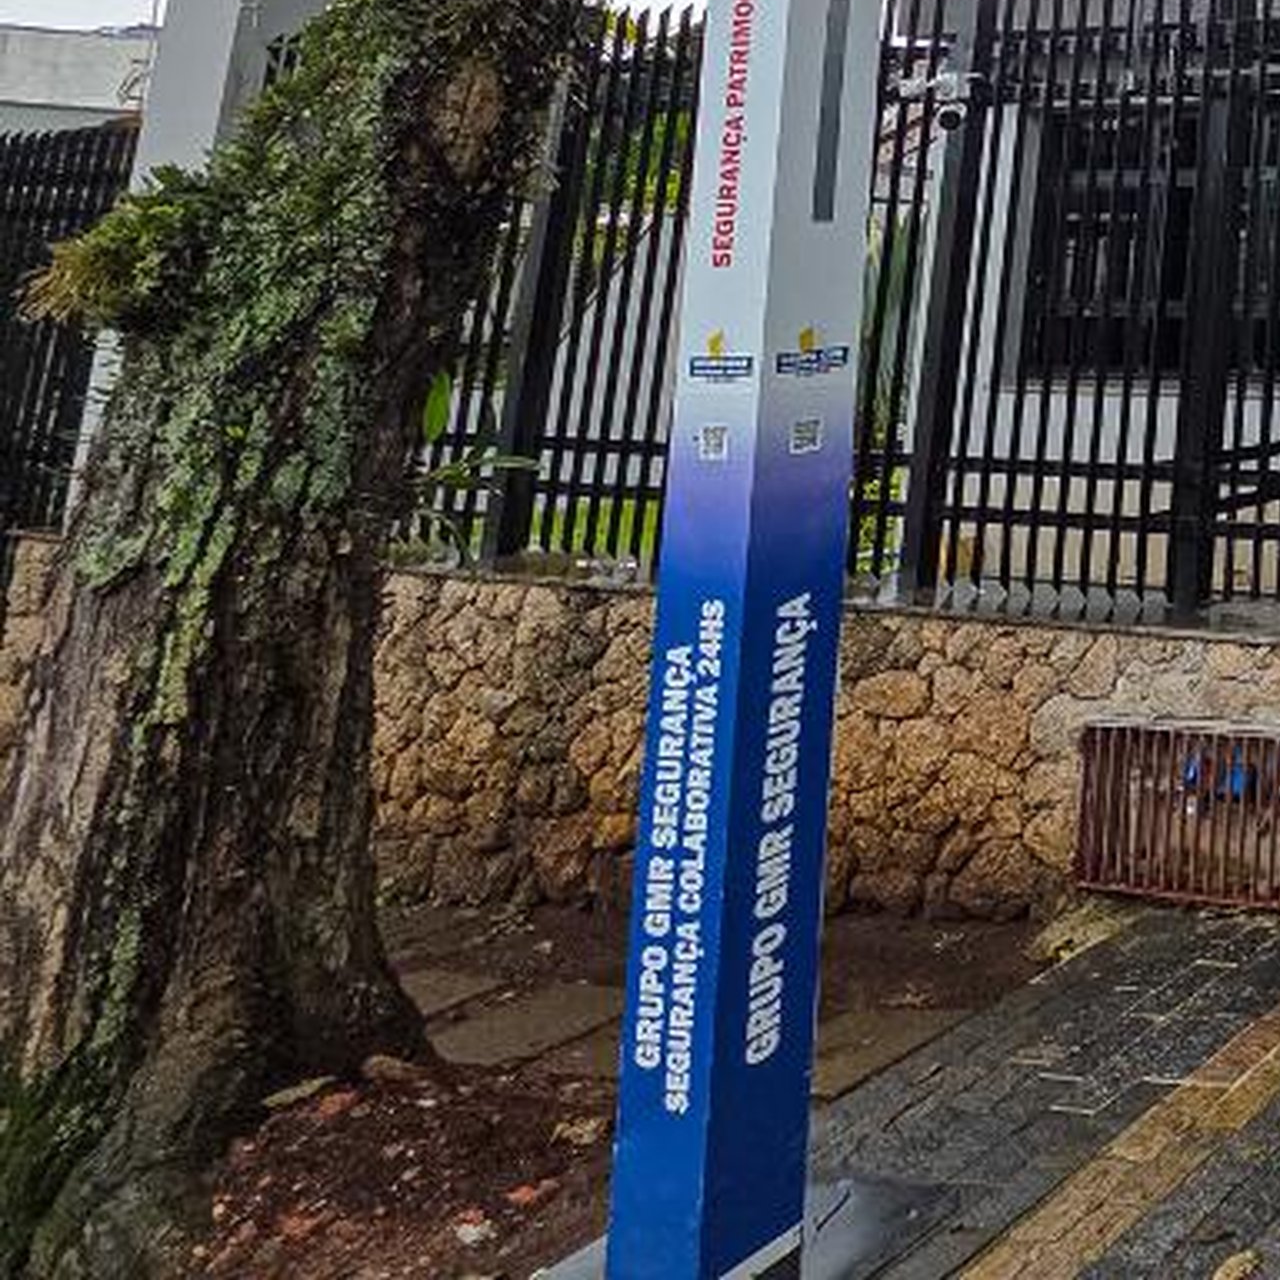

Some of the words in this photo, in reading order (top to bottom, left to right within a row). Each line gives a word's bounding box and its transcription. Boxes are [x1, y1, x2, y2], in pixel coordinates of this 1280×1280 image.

[712, 114, 748, 268] SEGURANÇA
[696, 598, 726, 678] 24HS
[760, 591, 818, 822] SEGURANÇA
[652, 644, 697, 851] SEGURANÇA
[677, 682, 719, 914] COLABORATIVA
[643, 855, 675, 937] GMR
[753, 823, 794, 919] GMR
[634, 945, 669, 1068] GRUPO
[663, 920, 705, 1115] SEGURANÇA
[745, 922, 788, 1065] GRUPO
